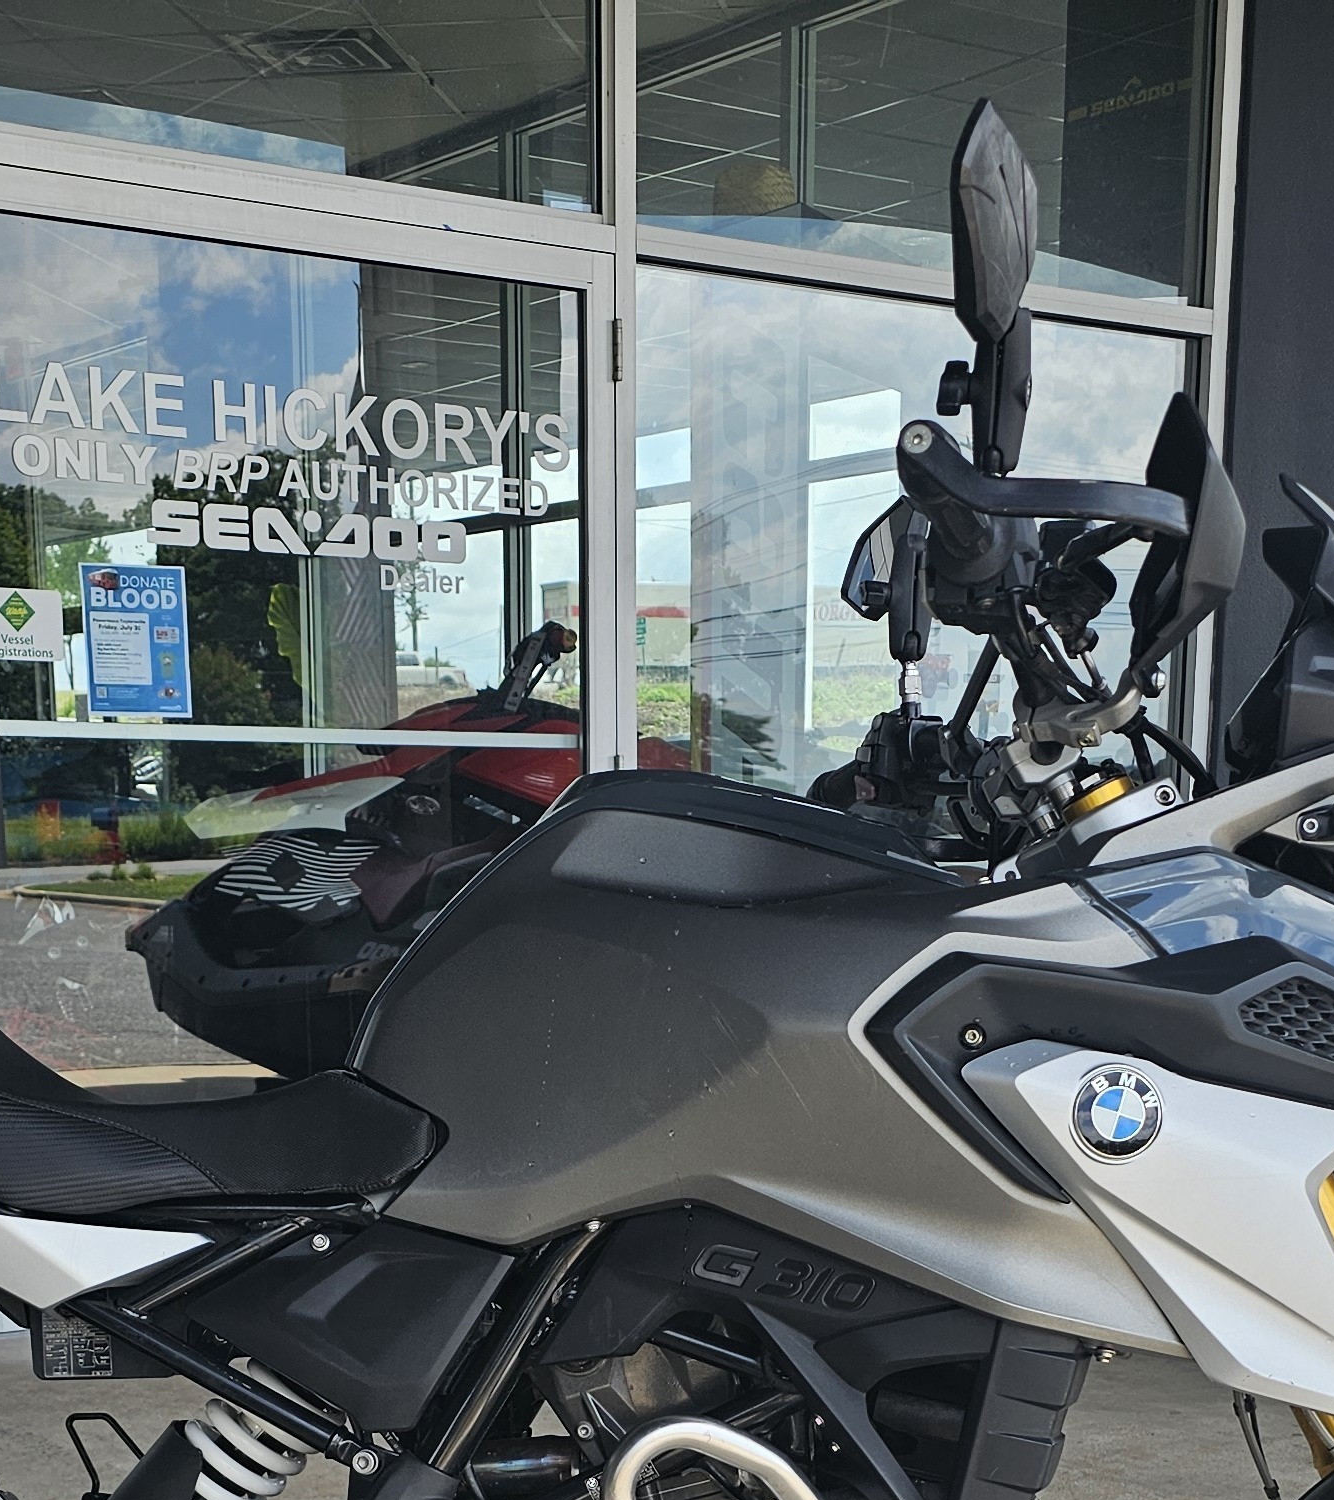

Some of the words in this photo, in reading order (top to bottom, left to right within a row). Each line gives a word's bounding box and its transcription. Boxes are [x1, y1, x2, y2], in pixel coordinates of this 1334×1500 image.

[212, 379, 571, 473] HICKORY'S
[11, 434, 157, 485] ONLY
[173, 448, 268, 495] BRP
[278, 459, 548, 518] AUTHORIZED
[120, 575, 175, 590] DONATE
[379, 564, 464, 595] Dealer
[90, 587, 178, 610] BLOOD
[1, 633, 34, 645] Vessel
[1090, 1072, 1158, 1109] BMW
[690, 1244, 760, 1288] G
[754, 1257, 876, 1312] 310
